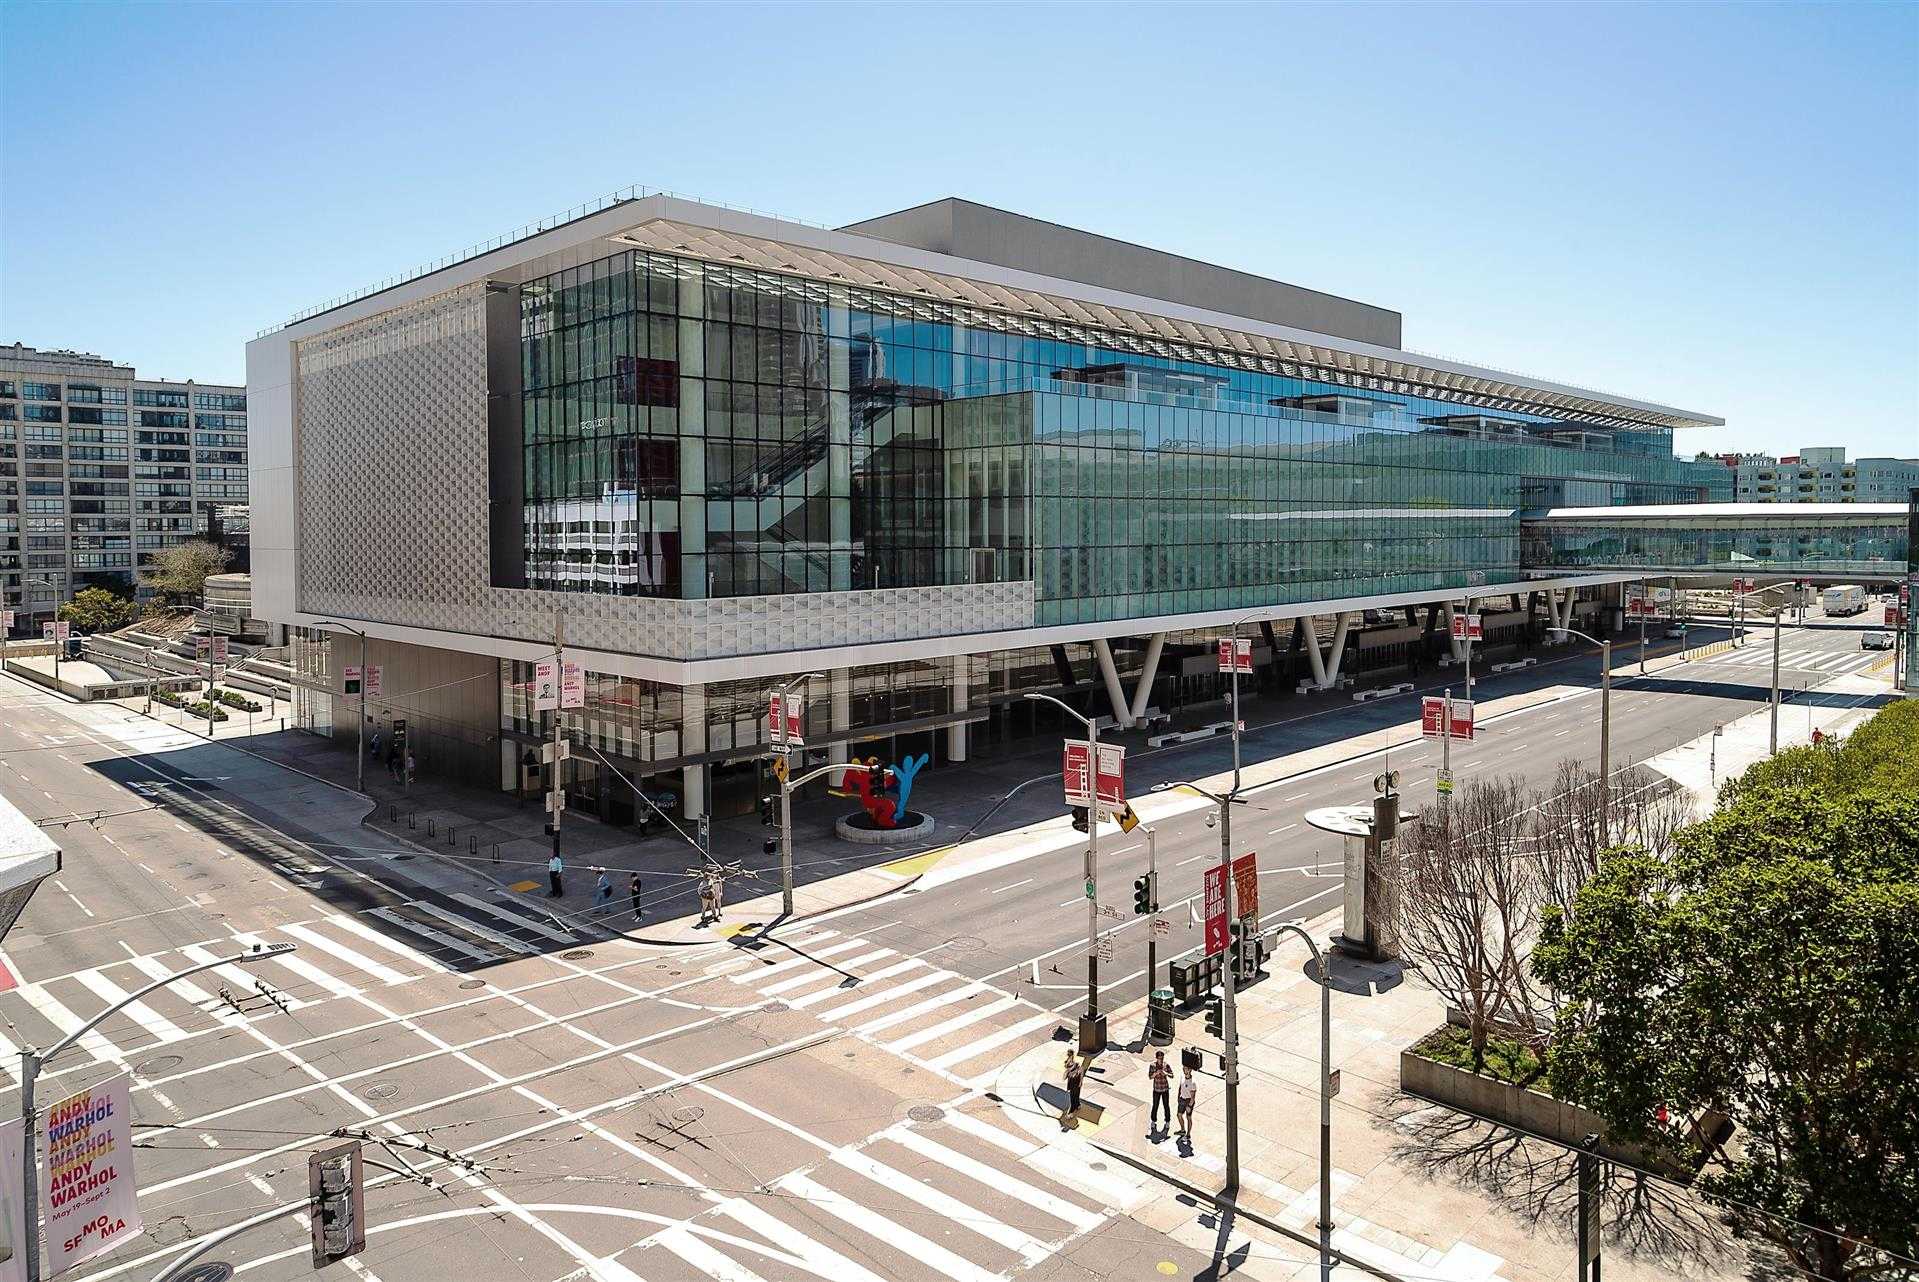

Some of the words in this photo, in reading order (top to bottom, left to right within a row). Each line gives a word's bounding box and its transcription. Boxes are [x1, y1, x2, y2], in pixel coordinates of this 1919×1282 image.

[1209, 898, 1226, 920] HERE
[49, 1096, 92, 1128] ANDY
[49, 1103, 114, 1143] WARHOL
[50, 1166, 118, 1209] WARHOL
[51, 1160, 93, 1193] ANDY
[52, 1208, 72, 1222] May
[104, 1187, 111, 1195] 2
